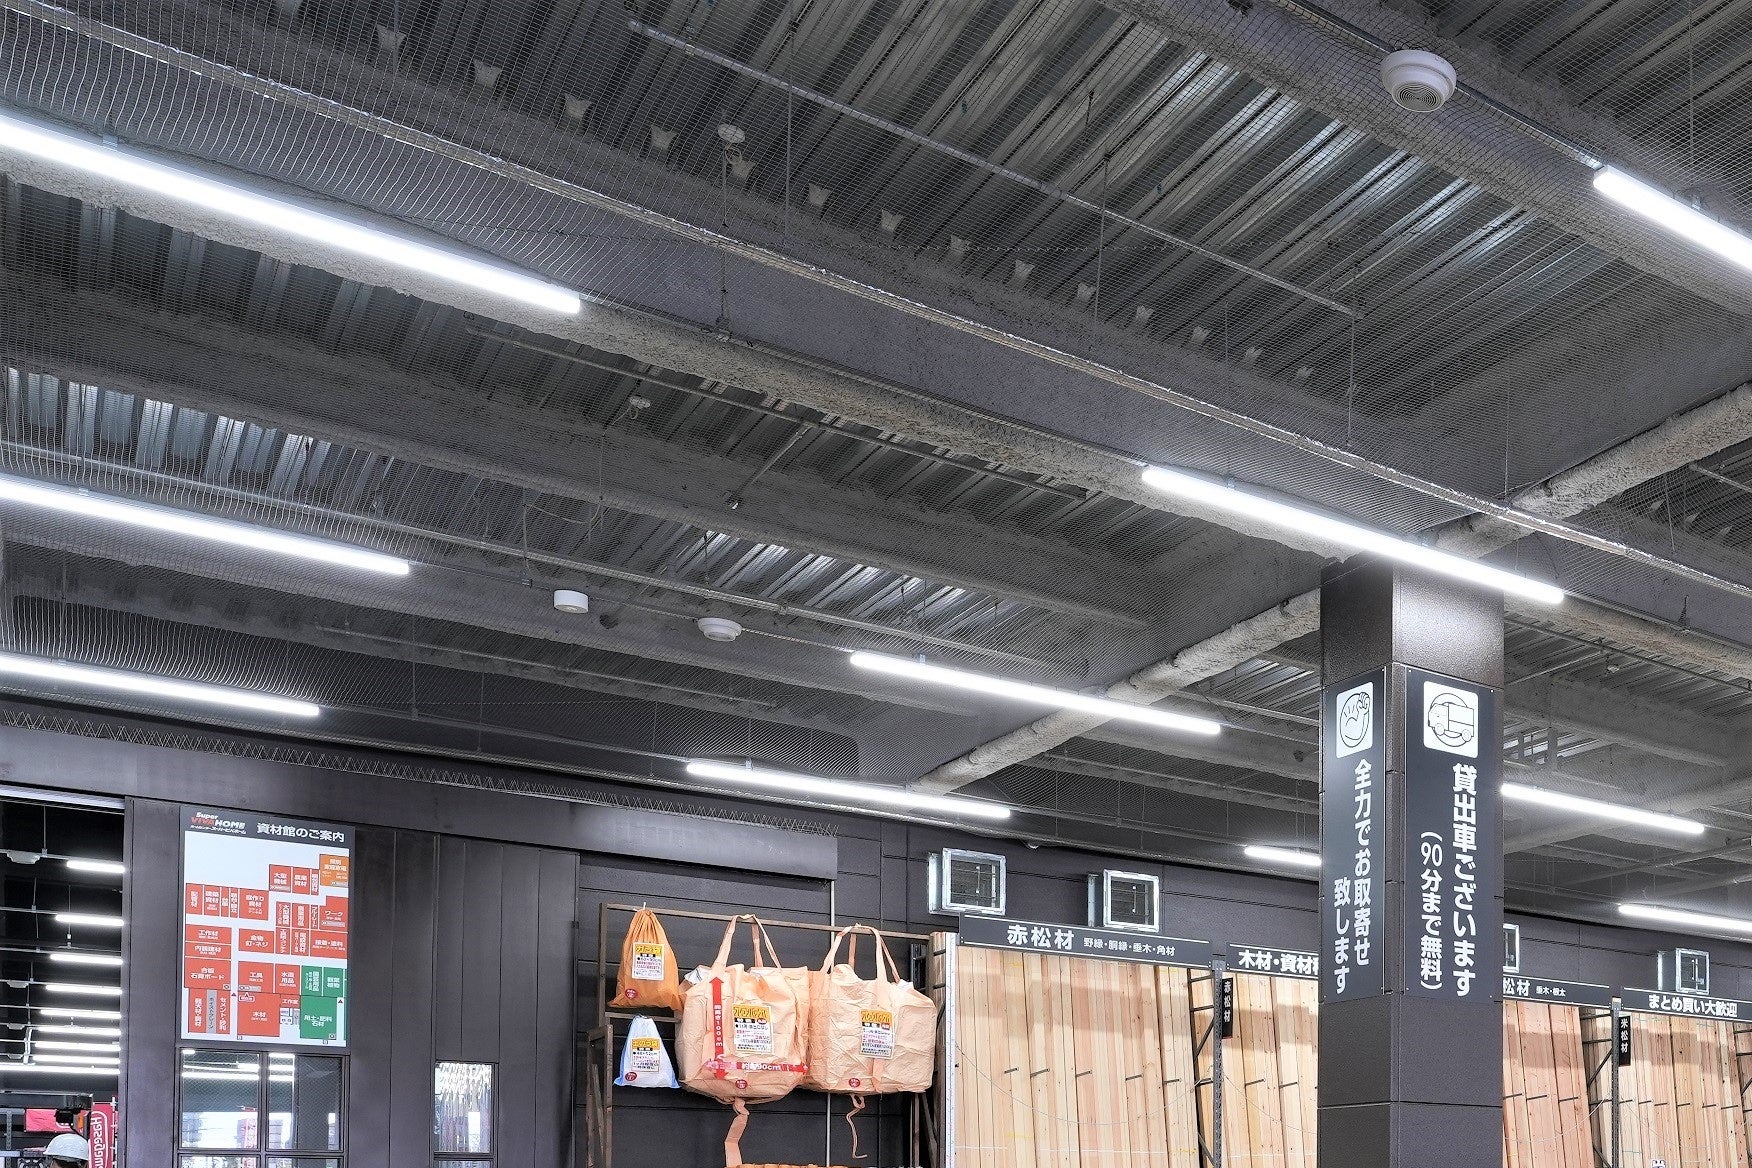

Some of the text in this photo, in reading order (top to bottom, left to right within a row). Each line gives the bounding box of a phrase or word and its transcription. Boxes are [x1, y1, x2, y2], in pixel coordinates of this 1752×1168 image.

[257, 823, 345, 843] 資材館のご案内
[1354, 759, 1371, 966] 全力でお取寄せ
[1420, 831, 1443, 991] (90分まで無料)
[1452, 763, 1477, 997] 貸出車ございます
[1007, 924, 1075, 951] 赤松材
[1334, 876, 1350, 995] 致します
[1619, 1017, 1629, 1053] 米松材
[1648, 994, 1738, 1018] まとめ買い大歓迎
